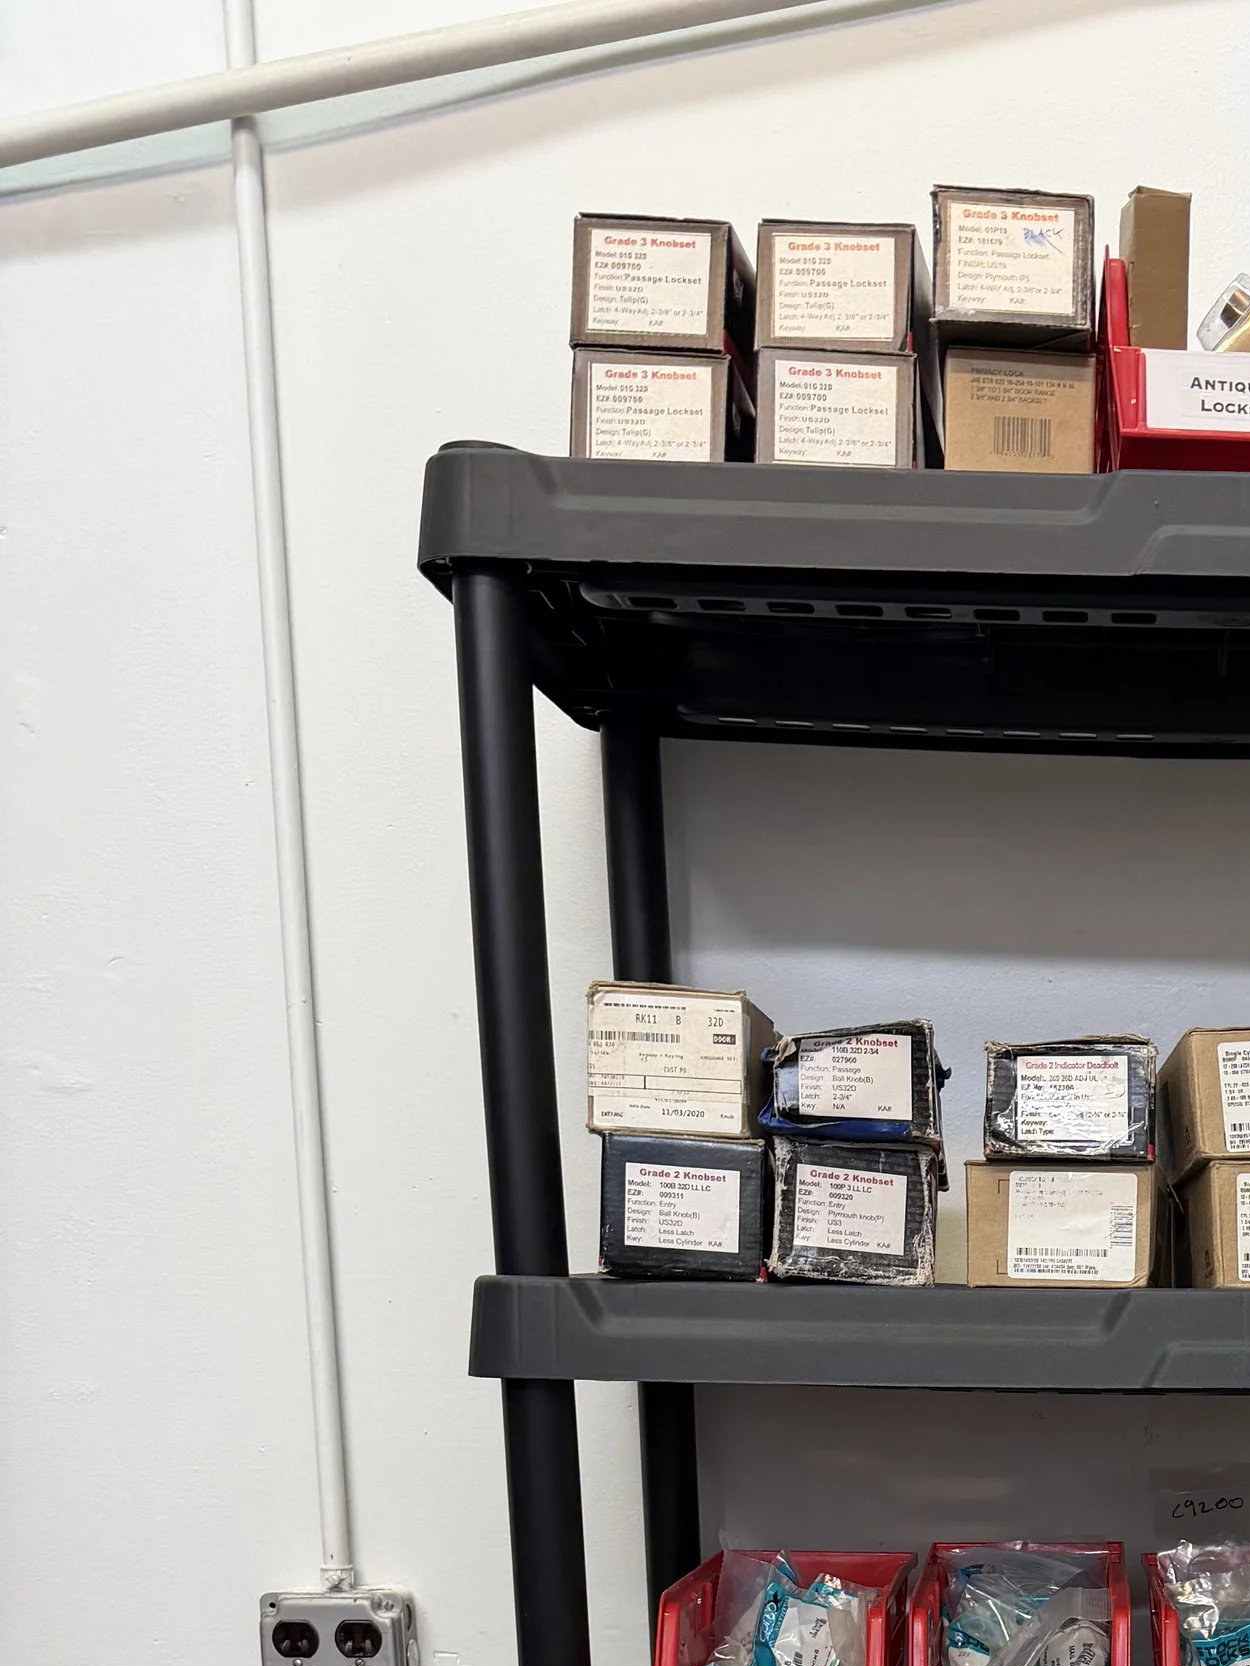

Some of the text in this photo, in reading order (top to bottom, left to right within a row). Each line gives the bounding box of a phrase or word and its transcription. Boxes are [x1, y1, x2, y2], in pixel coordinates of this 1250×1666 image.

[963, 209, 1059, 221] Grade 3 Knobset
[605, 236, 696, 248] Grade 3 Knobset
[788, 242, 880, 251] Grade 3 Knobset
[625, 274, 701, 284] Passage Lockset
[605, 370, 637, 378] Grade
[652, 371, 697, 380] Knobset
[789, 367, 821, 376] Grade
[836, 369, 881, 379] Knobset
[810, 404, 888, 415] Passage Lockset
[636, 1014, 723, 1027] RK11 B 32D
[856, 1038, 898, 1047] Knobset
[1087, 1061, 1119, 1069] Deadbolt
[662, 1109, 705, 1118] 11/03/2020
[640, 1169, 726, 1182] Grade 2 Knobset
[810, 1170, 840, 1179] Grade
[853, 1175, 894, 1186] Knobset
[1171, 1496, 1244, 1519] C9200
